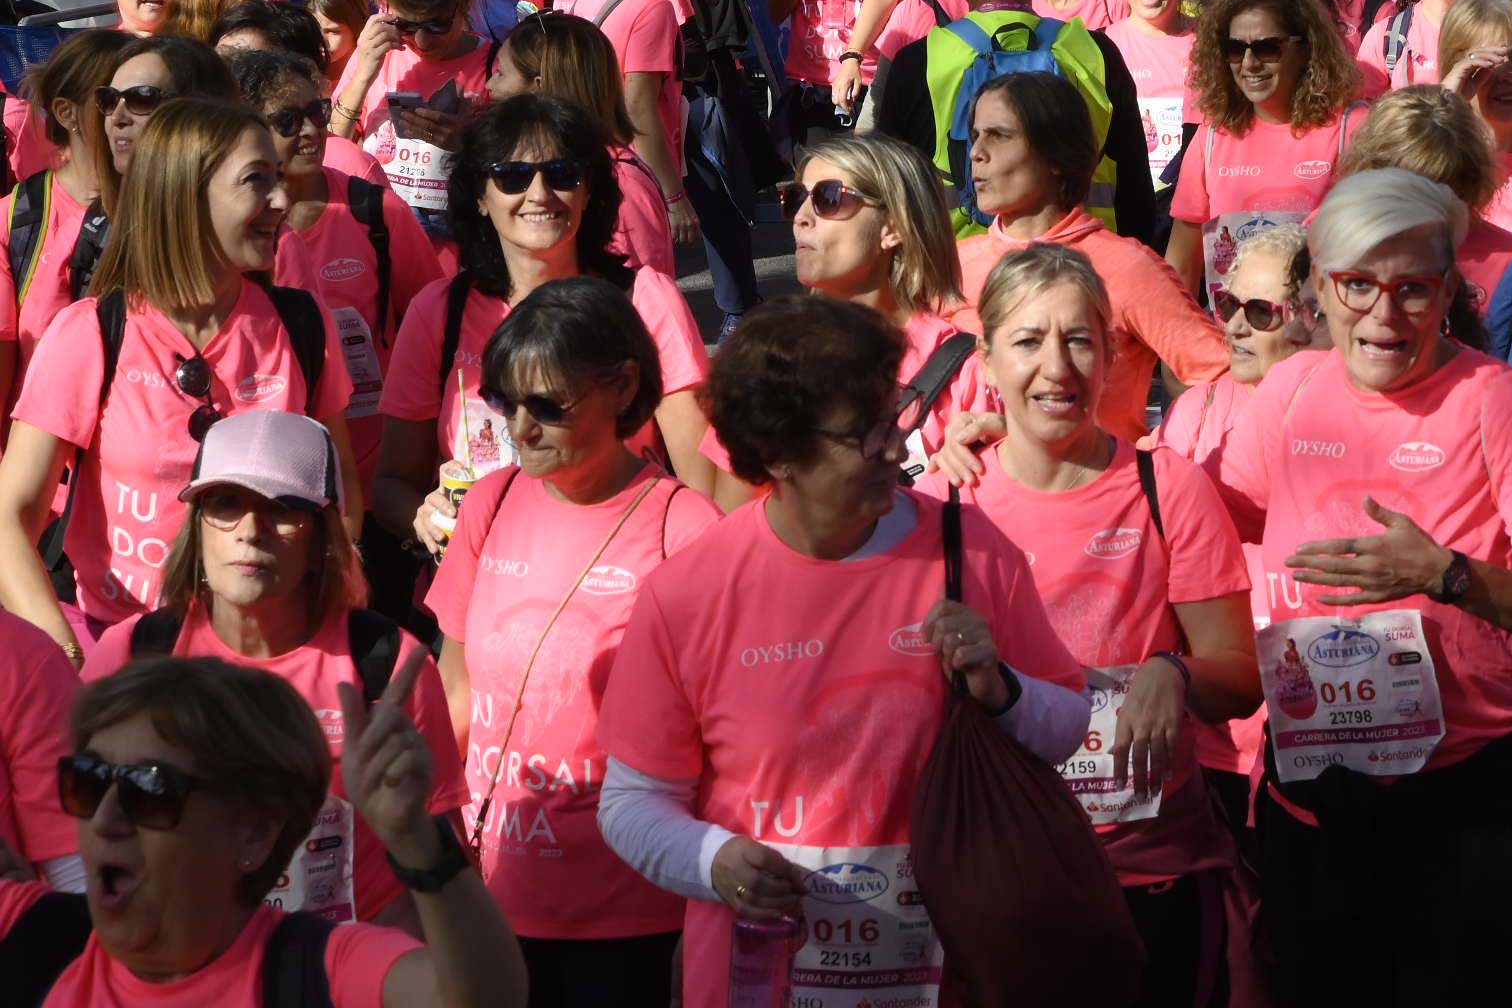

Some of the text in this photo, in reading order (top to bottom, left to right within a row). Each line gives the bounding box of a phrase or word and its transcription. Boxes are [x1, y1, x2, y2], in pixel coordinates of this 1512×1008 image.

[399, 148, 432, 164] 016
[115, 481, 157, 522] TU
[1266, 572, 1303, 609] TU
[1385, 631, 1416, 642] SUMA
[741, 639, 825, 668] OYSHO
[1314, 644, 1375, 660] ASTURIANA
[1320, 679, 1376, 704] 016
[1330, 710, 1373, 725] 23798
[1294, 732, 1338, 743] CARRERA
[1366, 729, 1399, 740] MUJER
[1072, 780, 1086, 791] LA
[751, 795, 804, 838] TU
[810, 878, 882, 894] ASTURIANA
[814, 918, 880, 945] 016
[820, 950, 872, 967] 22154
[824, 974, 840, 985] DE
[843, 974, 858, 985] LA
[860, 973, 899, 985] MUJER
